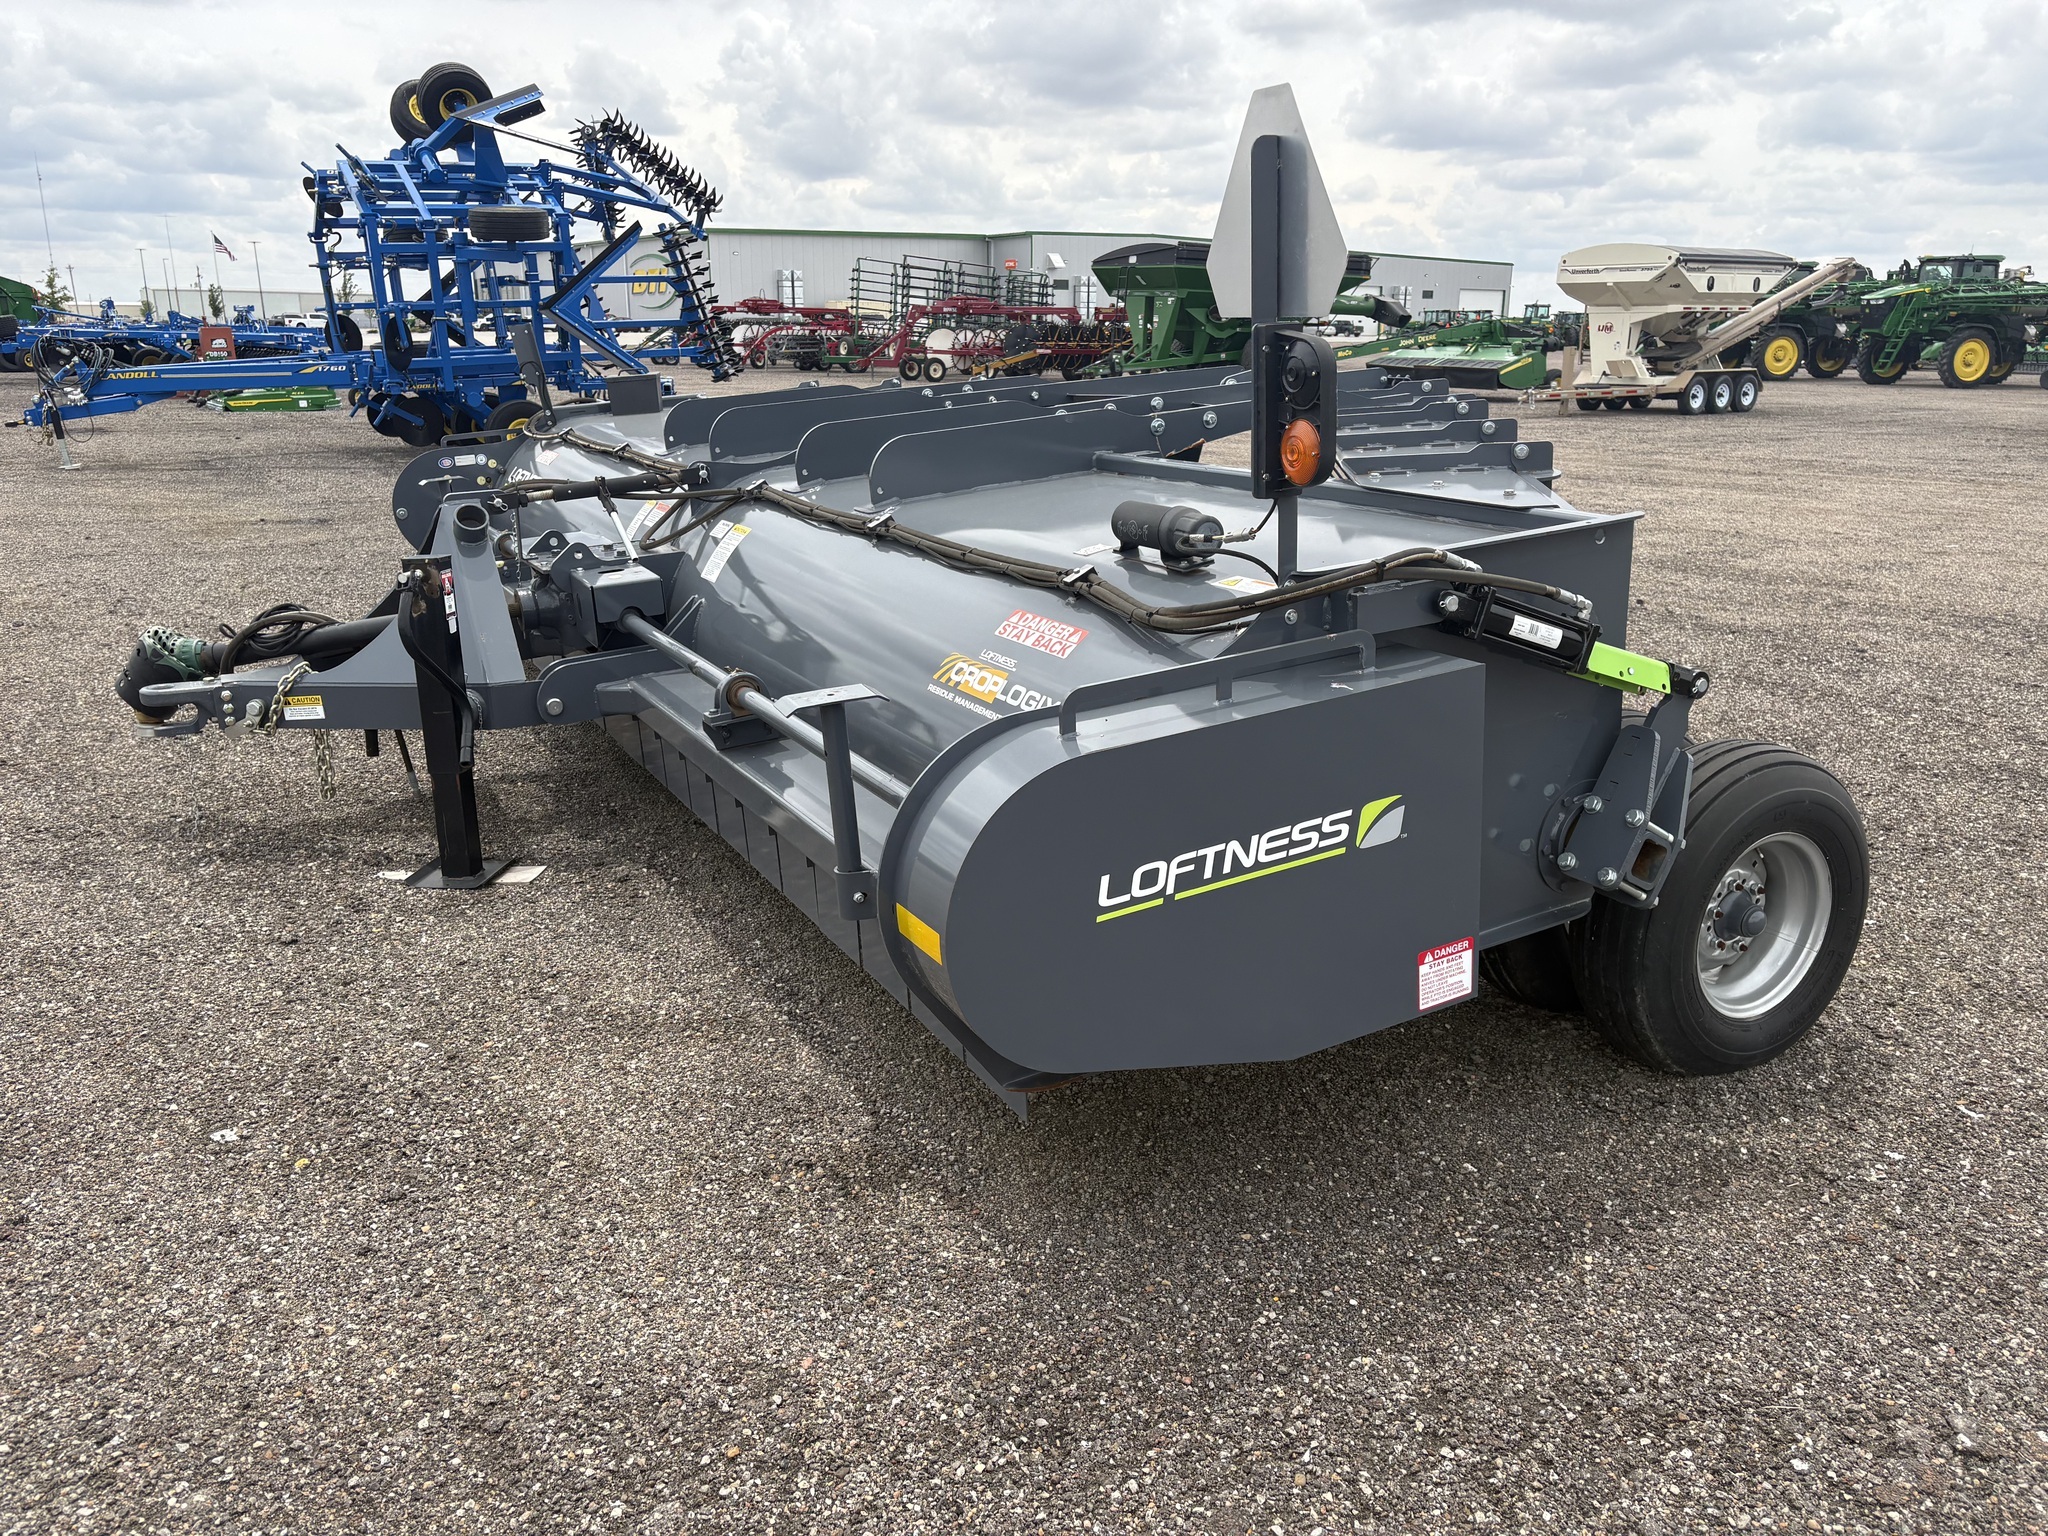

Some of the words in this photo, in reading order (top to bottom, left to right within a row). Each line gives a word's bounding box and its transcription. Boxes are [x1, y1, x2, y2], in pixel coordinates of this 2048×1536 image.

[1398, 338, 1415, 347] JOHN
[1417, 334, 1437, 343] DEERE
[101, 371, 159, 381] ANDOLL
[1020, 613, 1074, 640] DANGER
[998, 623, 1035, 643] STAY
[1032, 636, 1073, 657] BACK
[980, 648, 1017, 668] LOFTNESS
[291, 696, 320, 704] CAUTION
[927, 683, 955, 701] RESIDUE
[1098, 808, 1353, 907] LOFTNESS
[1434, 940, 1469, 959] DANGER
[1429, 960, 1445, 969] STAY
[1446, 954, 1463, 964] BACK
